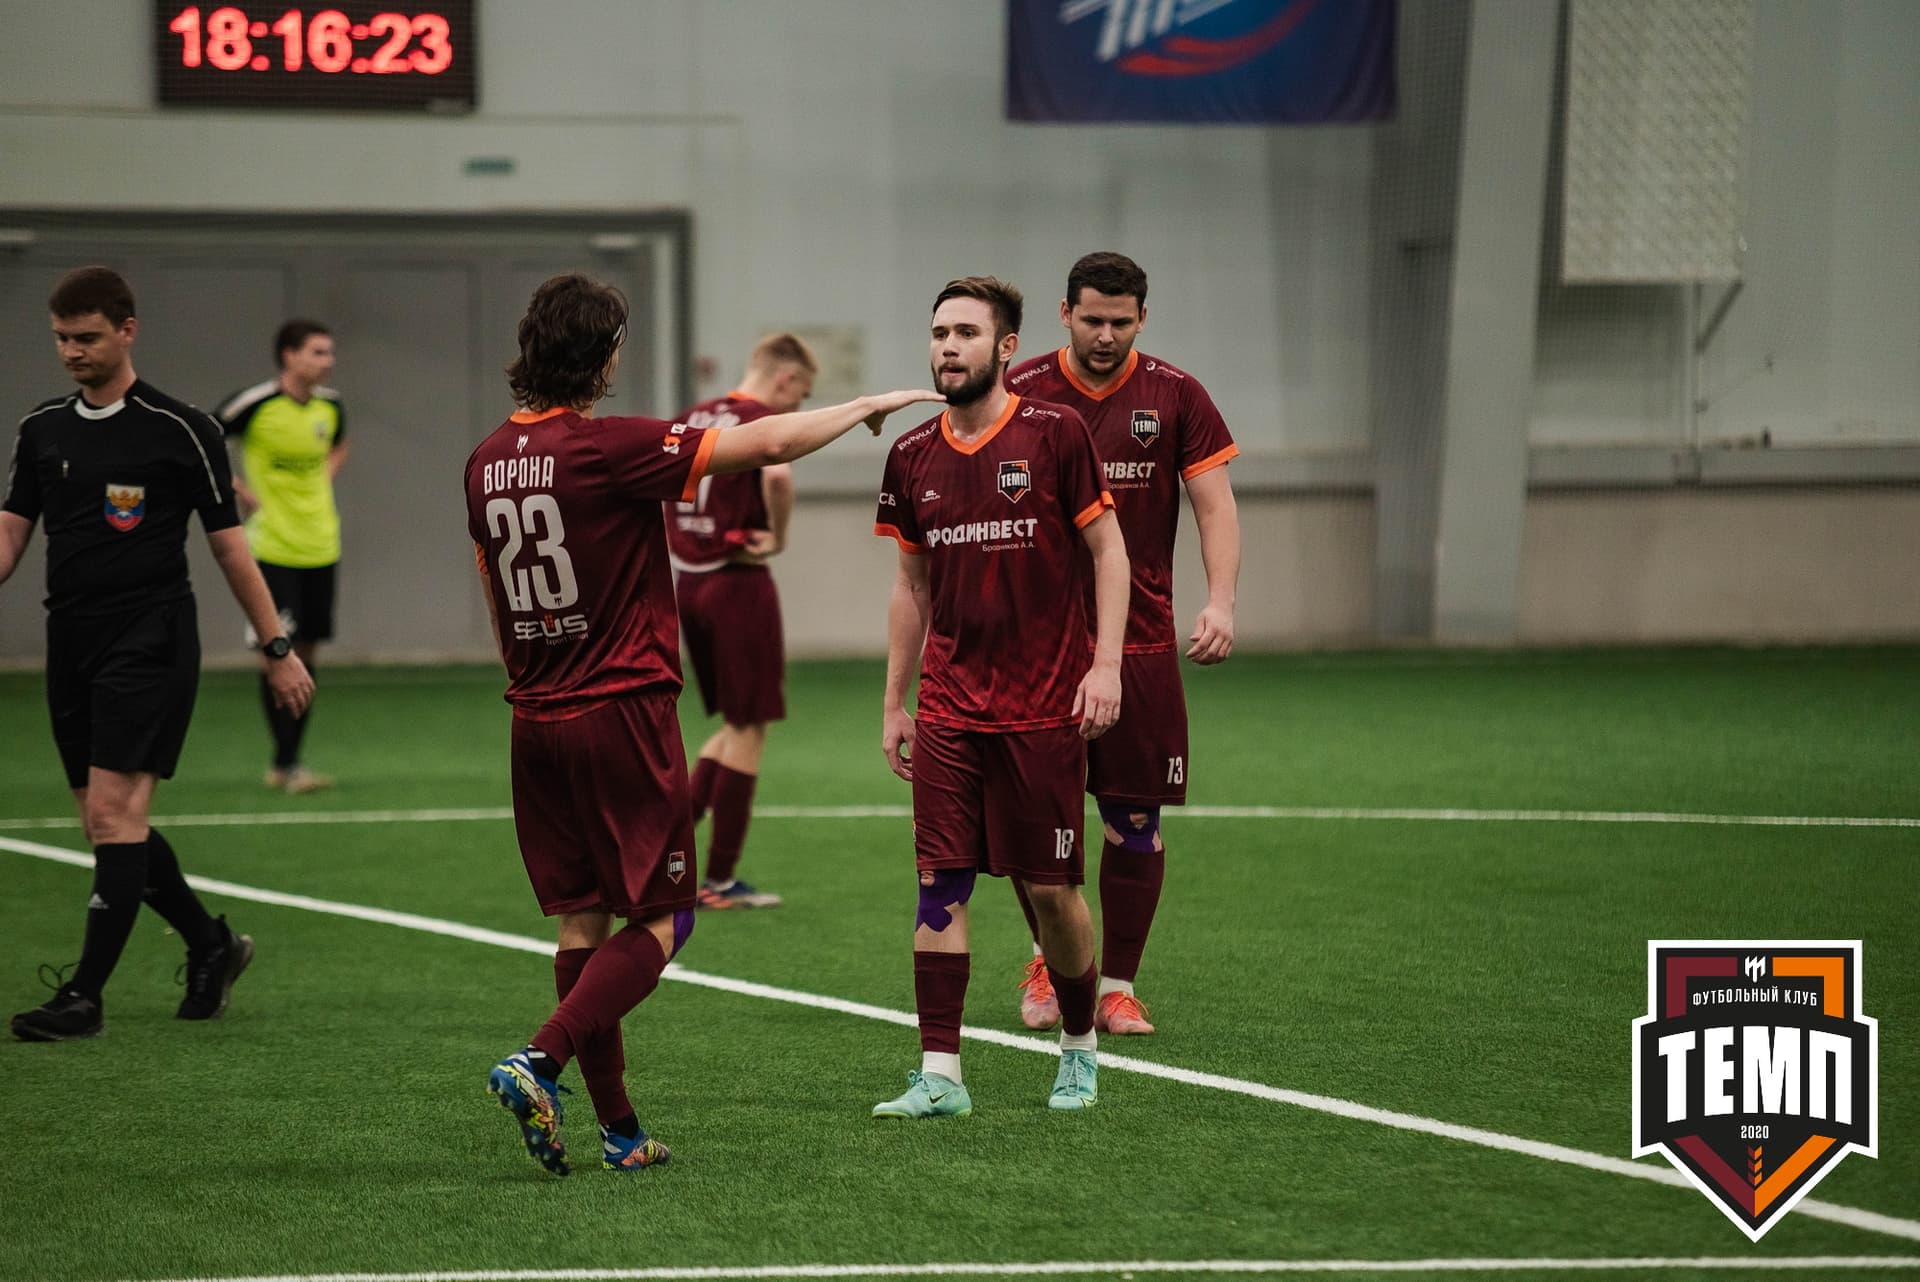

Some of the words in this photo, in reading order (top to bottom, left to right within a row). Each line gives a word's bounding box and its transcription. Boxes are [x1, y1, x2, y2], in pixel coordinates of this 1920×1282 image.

[169, 6, 453, 75] 18:16:23
[1134, 419, 1157, 434] ТЕМП
[484, 456, 555, 496] ВОРОНА
[1001, 473, 1028, 488] ТЕМП
[485, 494, 580, 612] 23
[513, 614, 588, 640] SEUS
[1167, 756, 1184, 785] 13
[1054, 828, 1074, 859] 18
